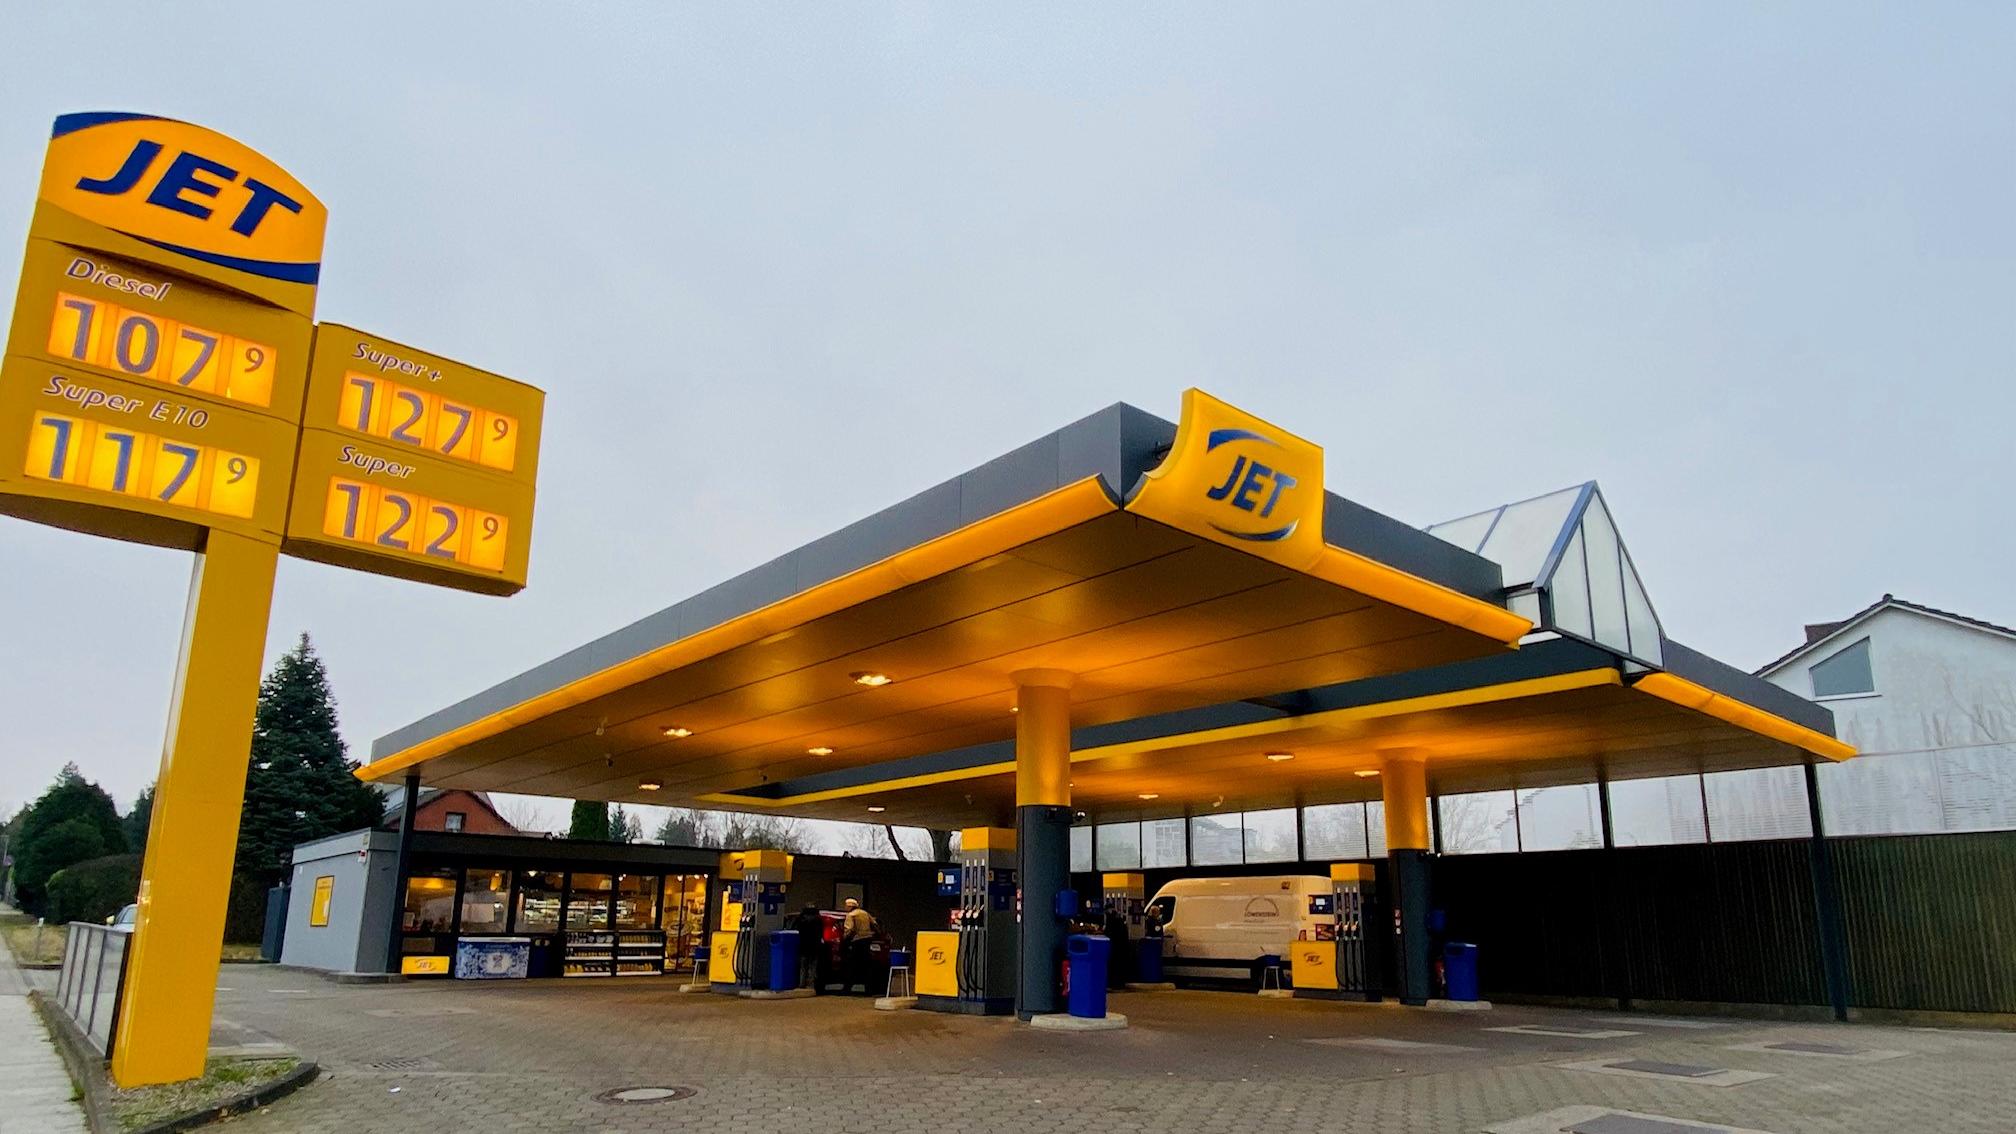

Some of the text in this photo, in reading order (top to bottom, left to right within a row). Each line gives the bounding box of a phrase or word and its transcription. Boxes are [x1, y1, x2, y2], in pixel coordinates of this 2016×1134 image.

[75, 139, 303, 238] JET
[65, 257, 171, 303] Diesel
[43, 374, 209, 431] Super E10
[336, 444, 416, 480] Super
[1206, 456, 1297, 518] JET
[929, 951, 944, 961] JET
